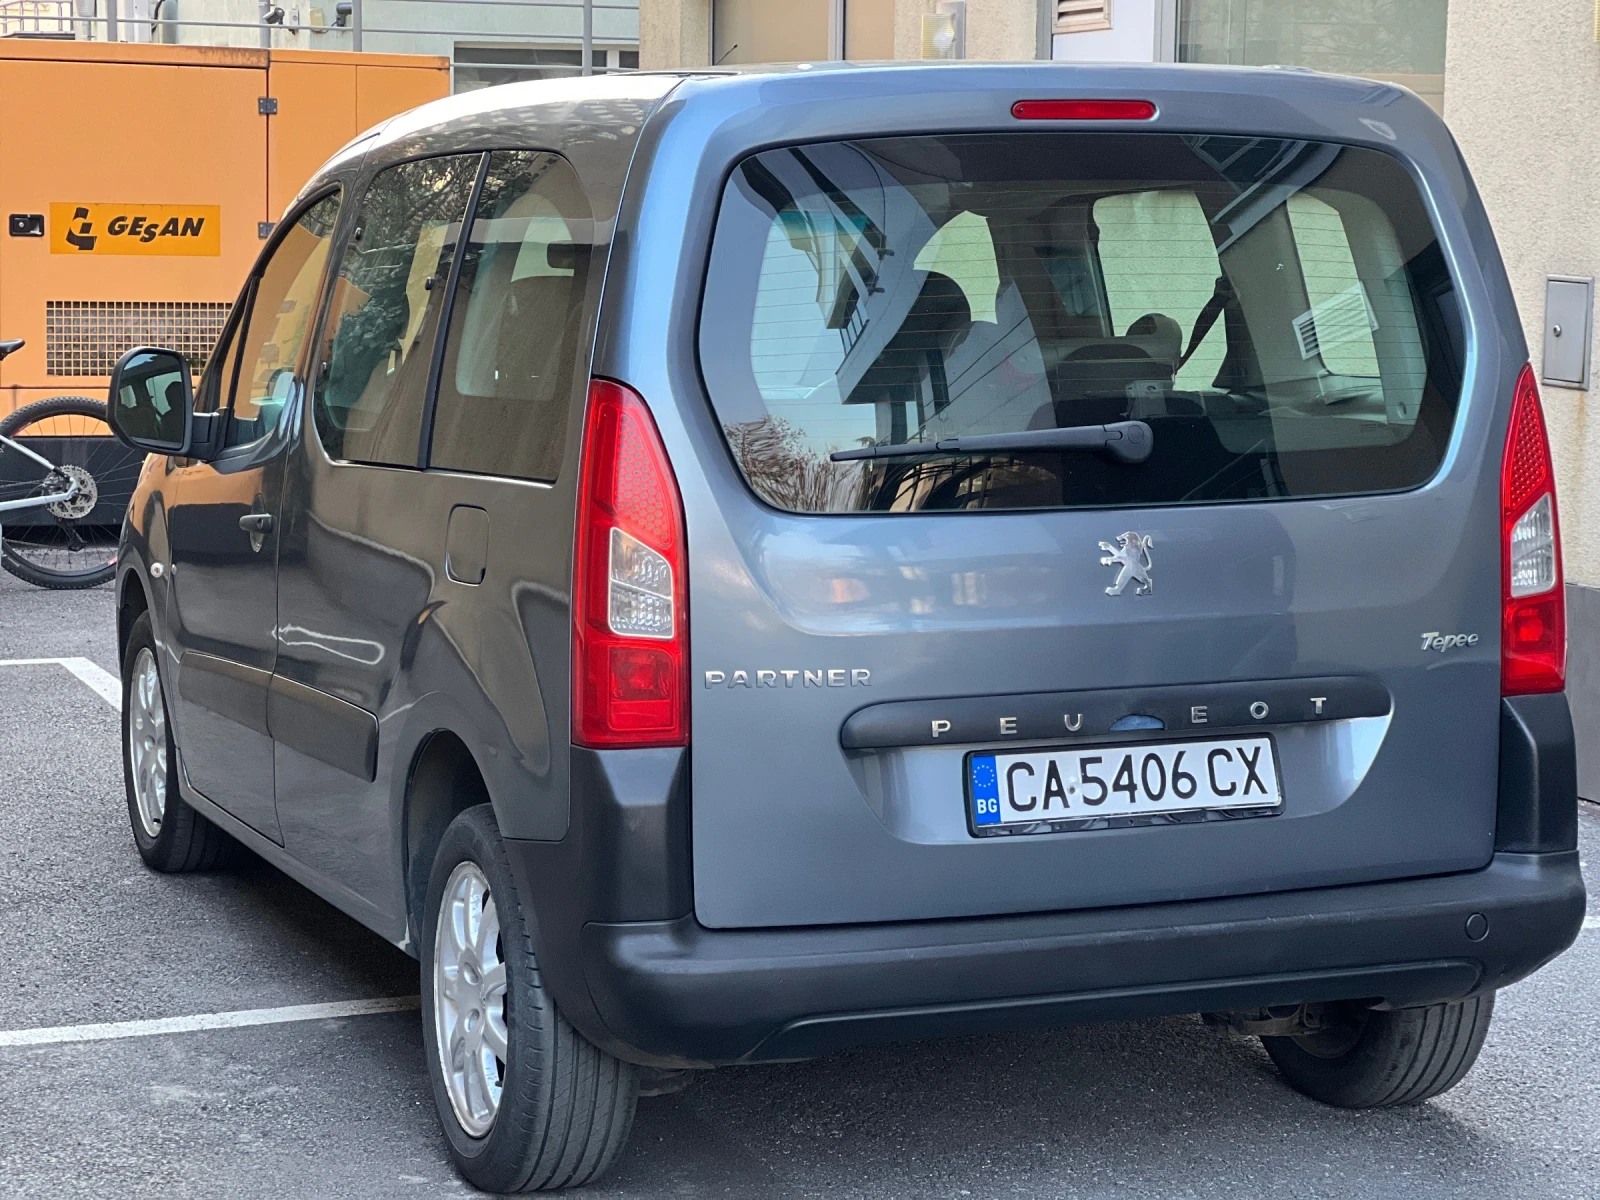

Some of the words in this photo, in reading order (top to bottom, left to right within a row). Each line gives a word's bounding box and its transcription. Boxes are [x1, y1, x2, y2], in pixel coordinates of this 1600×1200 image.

[1421, 631, 1479, 653] Tepee
[704, 668, 871, 689] PARTNER
[930, 696, 1327, 738] PEUEOT
[1006, 759, 1071, 812] CA
[1079, 750, 1198, 807] 5406
[1207, 745, 1269, 797] CX
[977, 798, 998, 815] BG
